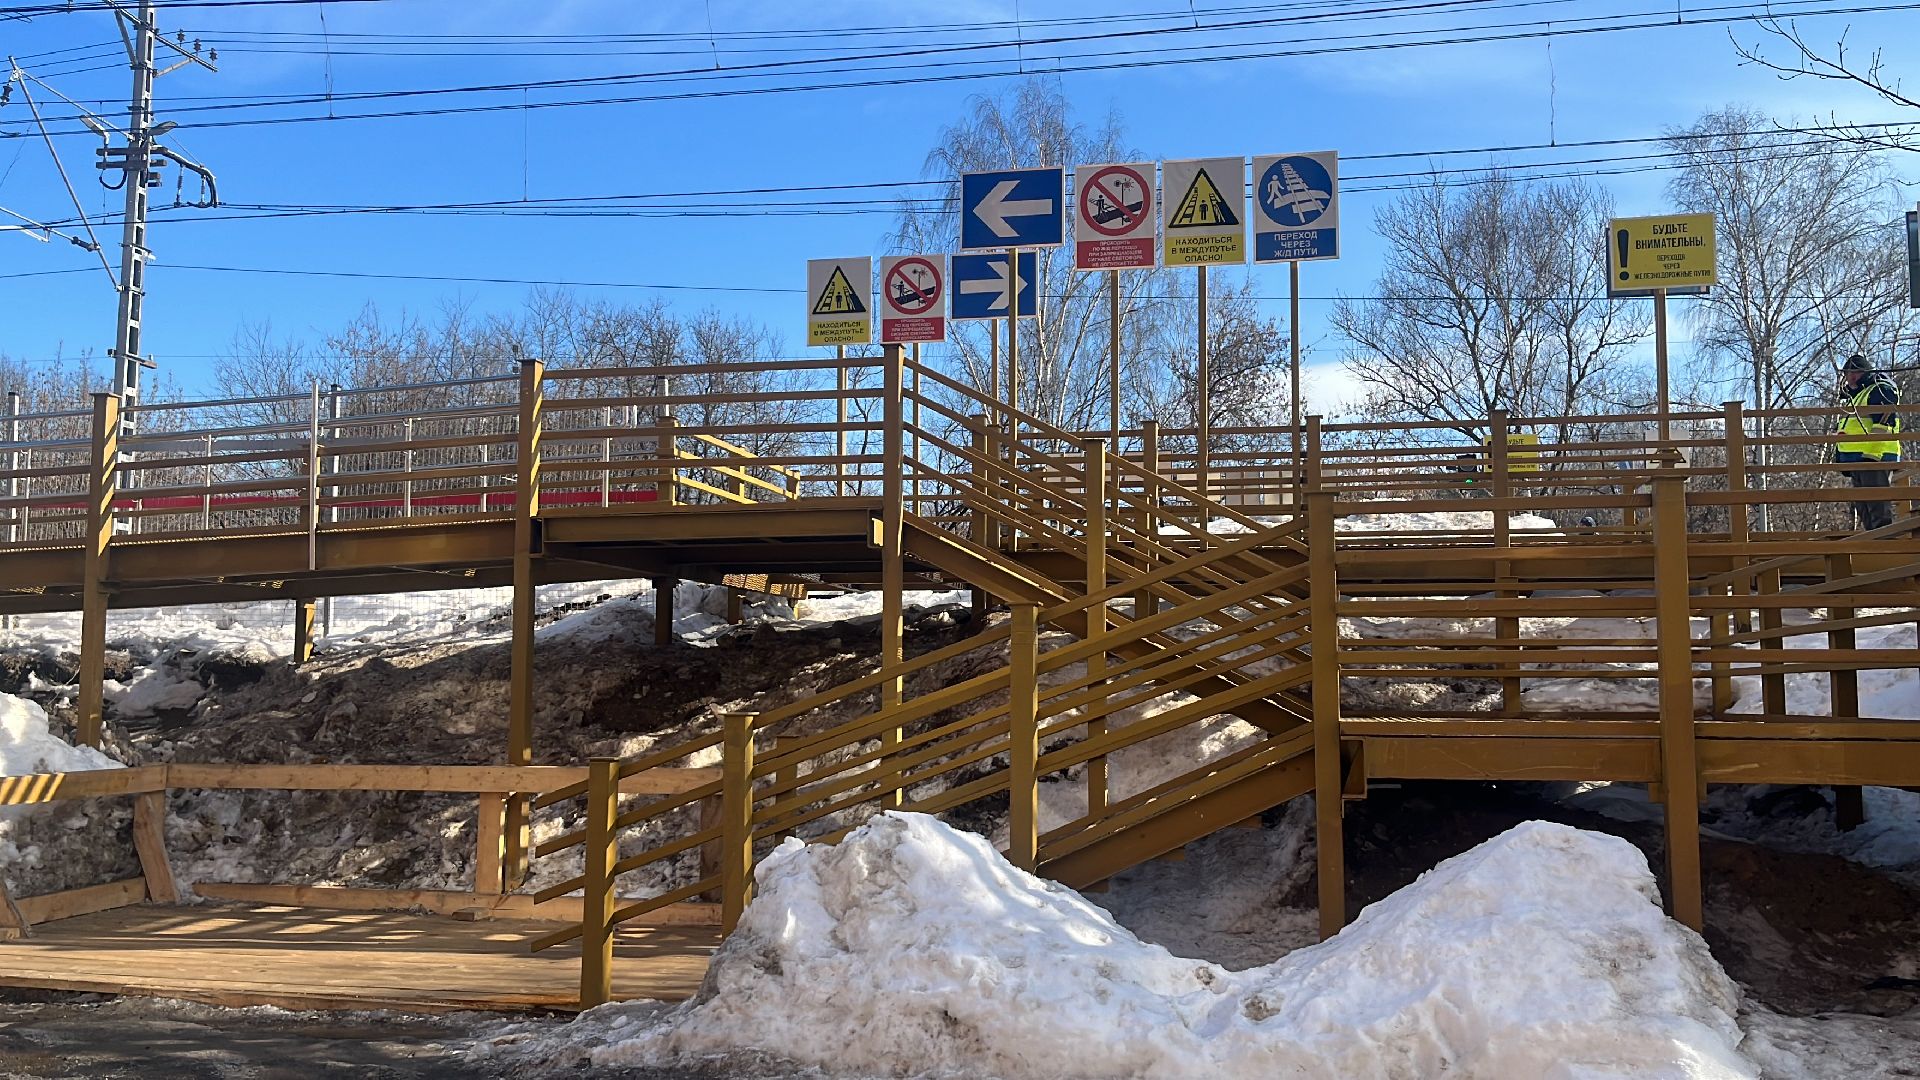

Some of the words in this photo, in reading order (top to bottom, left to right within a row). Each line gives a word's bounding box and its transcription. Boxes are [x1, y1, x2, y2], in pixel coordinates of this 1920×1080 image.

[1652, 223, 1688, 235] БУДЬТЕ
[1274, 231, 1317, 240] ПЕРЕХОД
[1175, 236, 1232, 245] НАХОДИТЬСЯ
[1281, 240, 1310, 248] ЧЕРЕЗ
[1635, 236, 1706, 249] ВНИМАТЕЛЬНЫ,
[1179, 245, 1237, 254] МЕЖДУПУТЬЕ
[1274, 250, 1291, 258] Ж/Д
[1293, 248, 1317, 256] ПУТИ
[1184, 254, 1223, 262] ОПАСНО!
[817, 321, 861, 329] НАХОДИТЬСЯ
